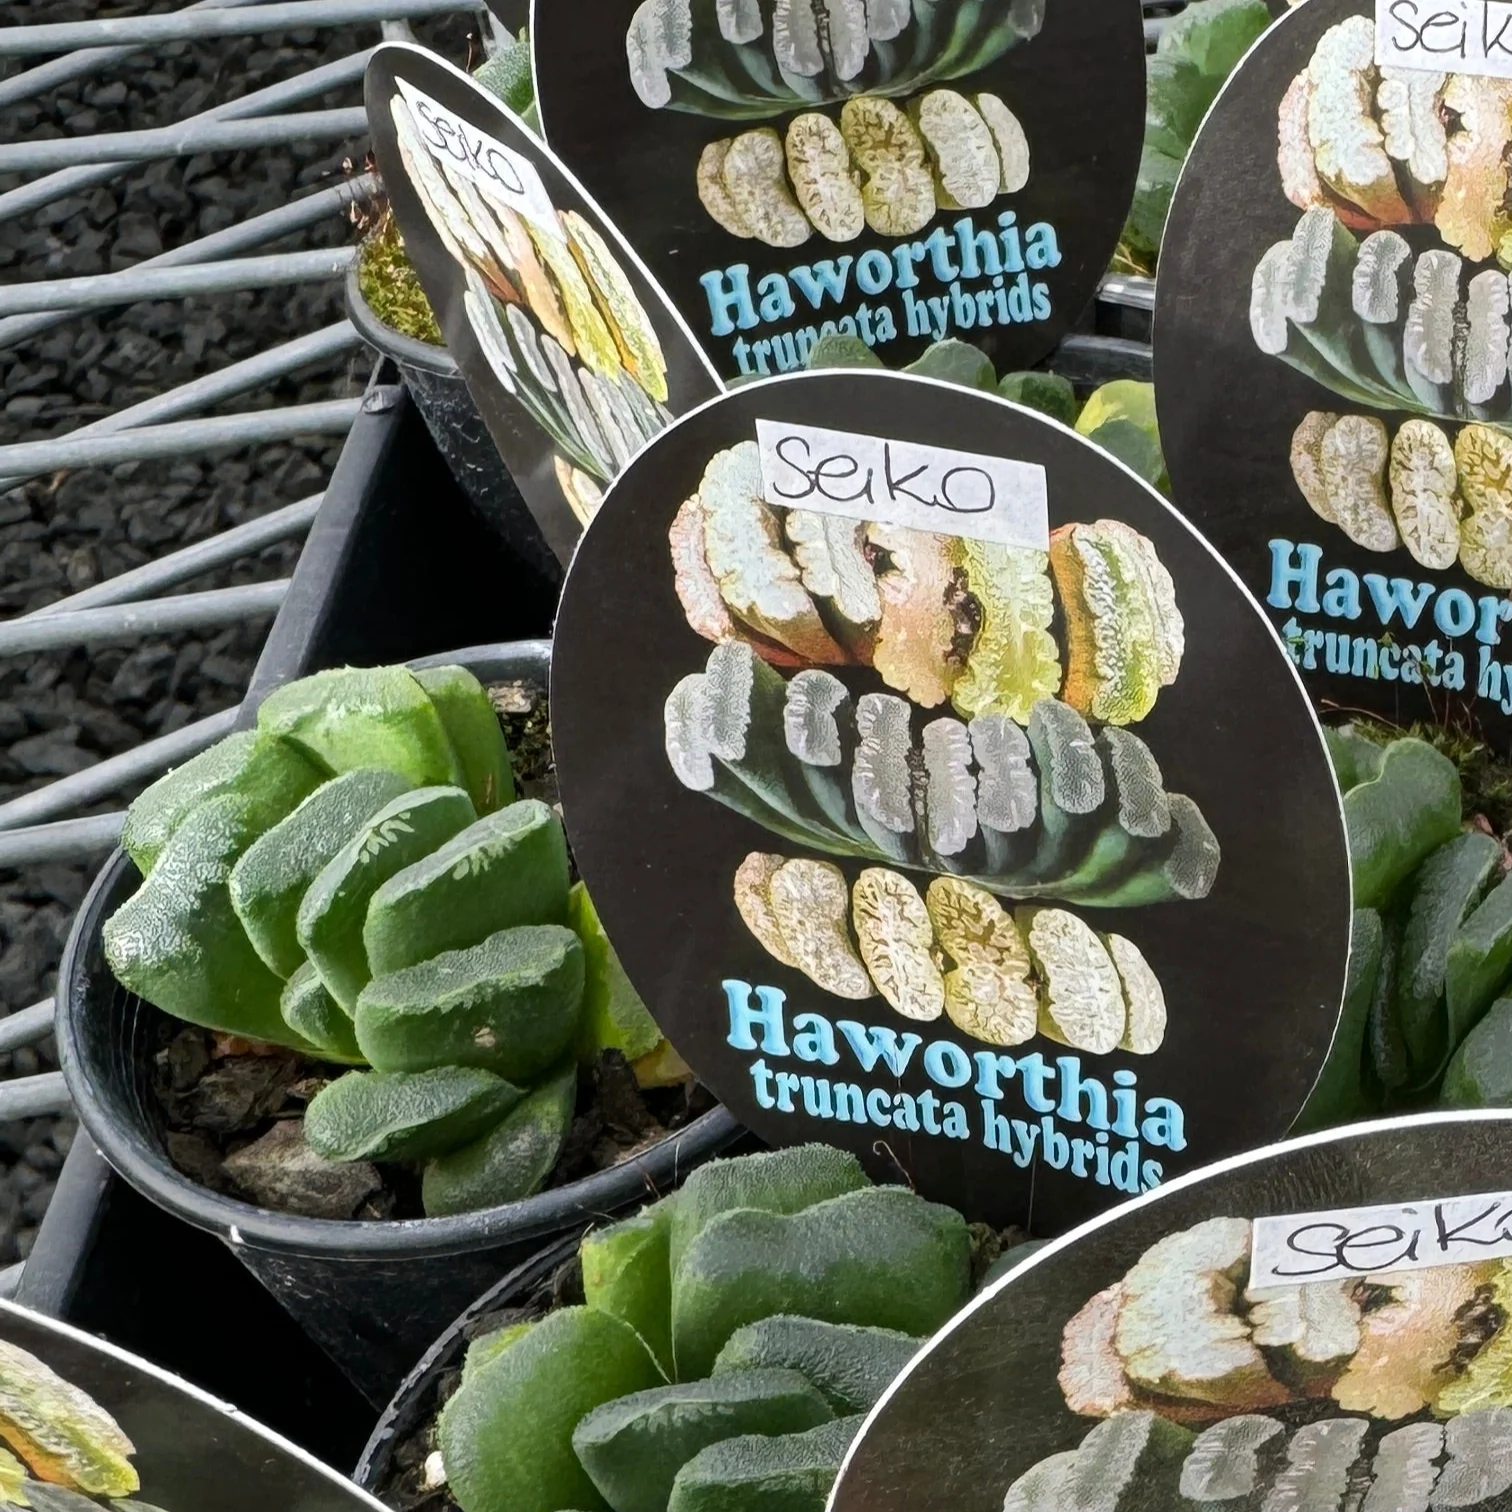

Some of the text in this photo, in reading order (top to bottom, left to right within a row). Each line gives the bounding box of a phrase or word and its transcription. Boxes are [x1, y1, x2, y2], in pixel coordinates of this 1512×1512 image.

[699, 209, 1063, 337] Haworthia
[902, 271, 1052, 342] hybrids
[1282, 616, 1466, 692] truncata
[721, 978, 1188, 1152] Haworthia
[749, 1057, 1164, 1195] truncata hybrids
